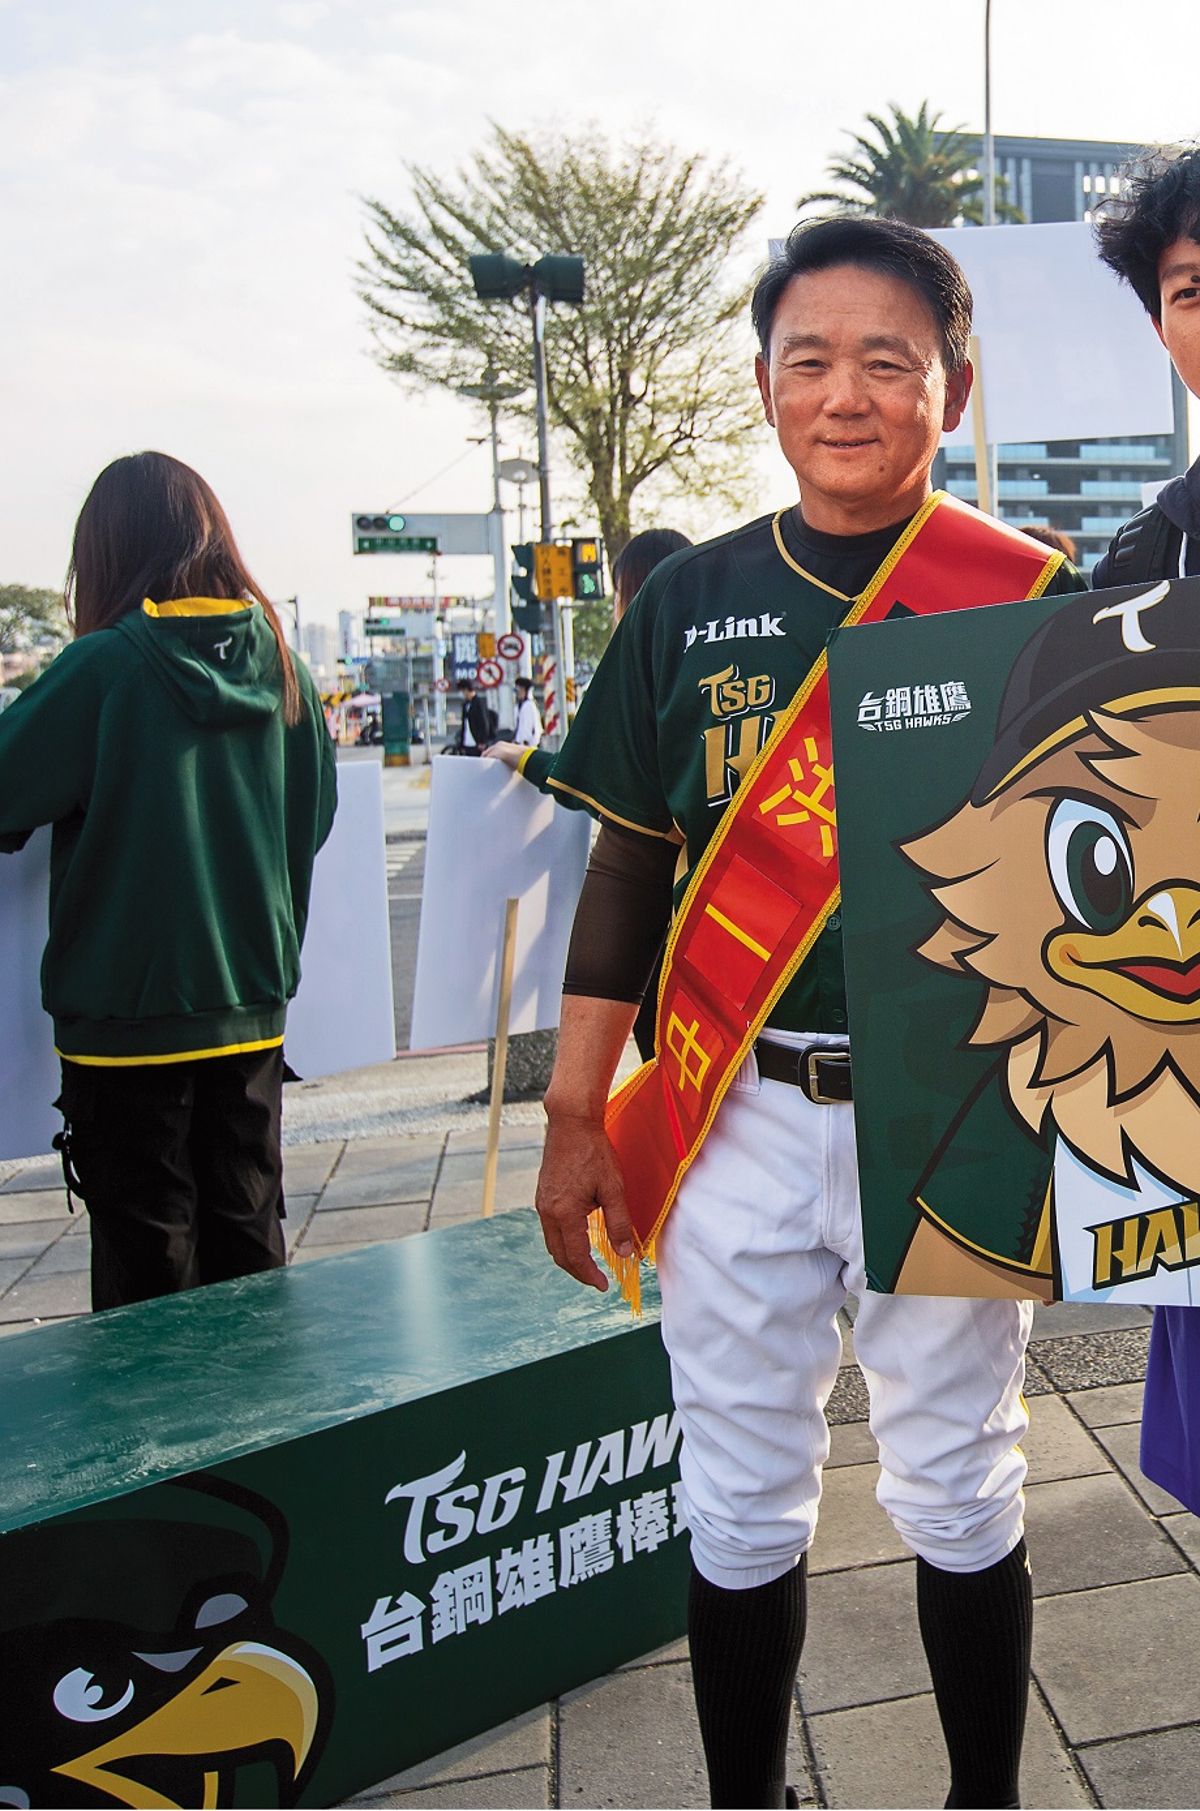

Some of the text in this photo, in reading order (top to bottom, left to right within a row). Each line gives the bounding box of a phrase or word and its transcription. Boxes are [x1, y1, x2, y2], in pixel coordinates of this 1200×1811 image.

[697, 663, 776, 721] TSG
[857, 681, 972, 722] 台鋼雄鷹
[873, 713, 952, 732] TSG HAWKS
[384, 1449, 527, 1565] TSG
